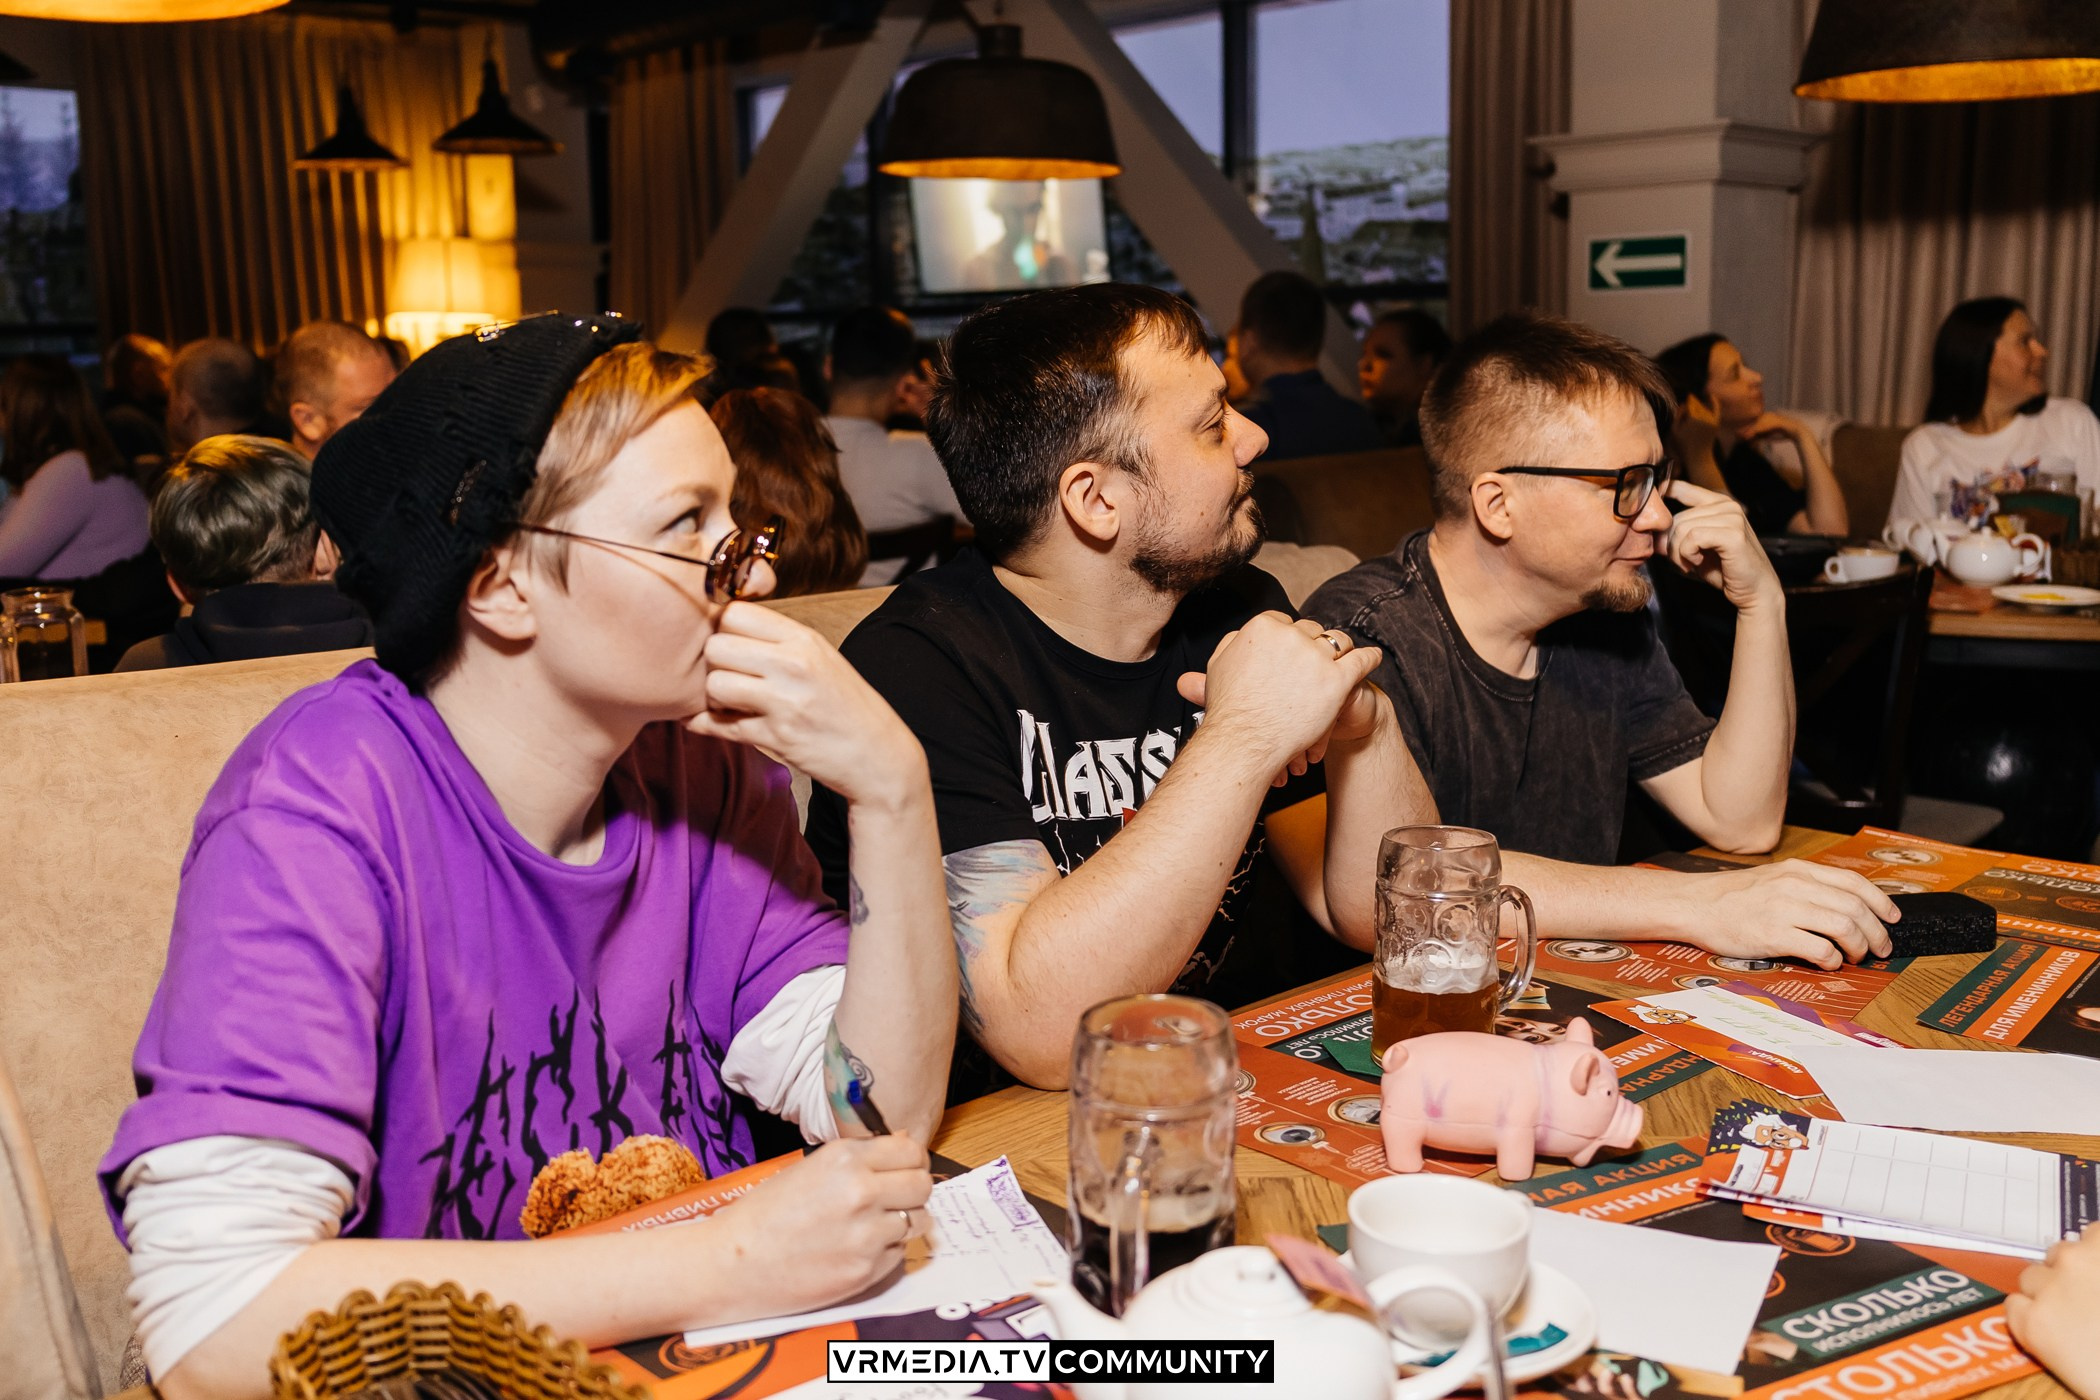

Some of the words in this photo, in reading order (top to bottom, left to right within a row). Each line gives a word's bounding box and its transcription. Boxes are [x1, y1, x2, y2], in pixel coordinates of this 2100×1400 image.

[1343, 979, 1373, 994] РИМ
[1938, 969, 2011, 1028] ЛЕГЕНДАРНАЯ
[2001, 943, 2039, 970] АКЦИЯ
[1983, 1016, 2019, 1040] ДЛЯ
[2003, 950, 2081, 1018] ИМЕНИННИКОВ
[1254, 994, 1373, 1037] ОЛЬКО
[1286, 991, 1342, 1013] ПИВНЫХ
[1234, 1009, 1288, 1030] МАРОК
[1308, 1015, 1373, 1042] ОЛНИЛОСЬ
[1285, 1039, 1311, 1050] ЛЕТ
[1609, 1042, 1664, 1068] ИМЕ
[1619, 1054, 1703, 1096] НДАРНА
[1593, 1153, 1696, 1187] АКЦИЯ
[1783, 1270, 1969, 1339] СКОЛЬКО
[1946, 1287, 1984, 1307] ЛЕТ
